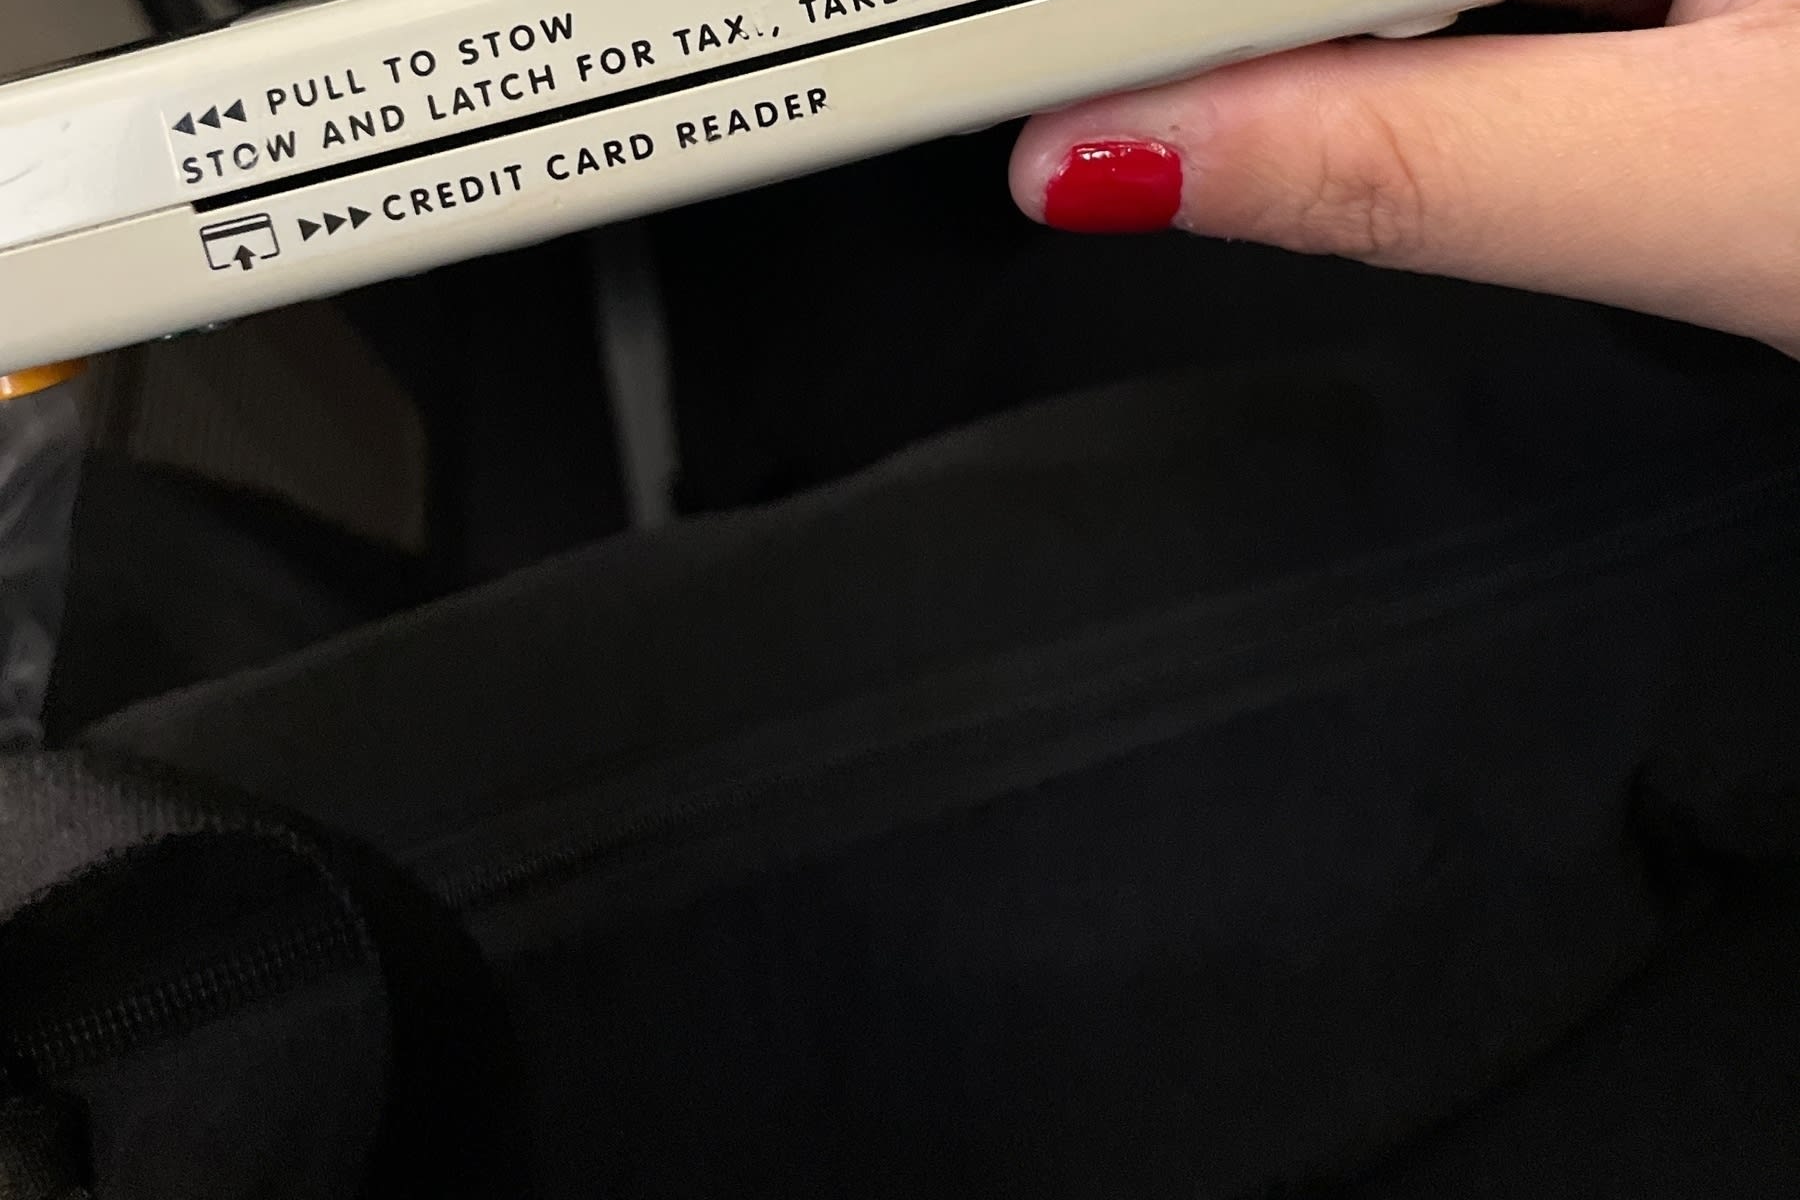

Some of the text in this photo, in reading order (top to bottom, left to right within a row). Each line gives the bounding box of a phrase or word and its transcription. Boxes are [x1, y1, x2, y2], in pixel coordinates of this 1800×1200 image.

[182, 130, 296, 184] STOW
[322, 104, 405, 149] AND
[427, 64, 556, 121] LATCH
[576, 39, 655, 82] FOR
[673, 14, 780, 56] TAX,
[266, 12, 573, 115] PULL TO STOW
[382, 87, 828, 221] CREDIT CARD READER
